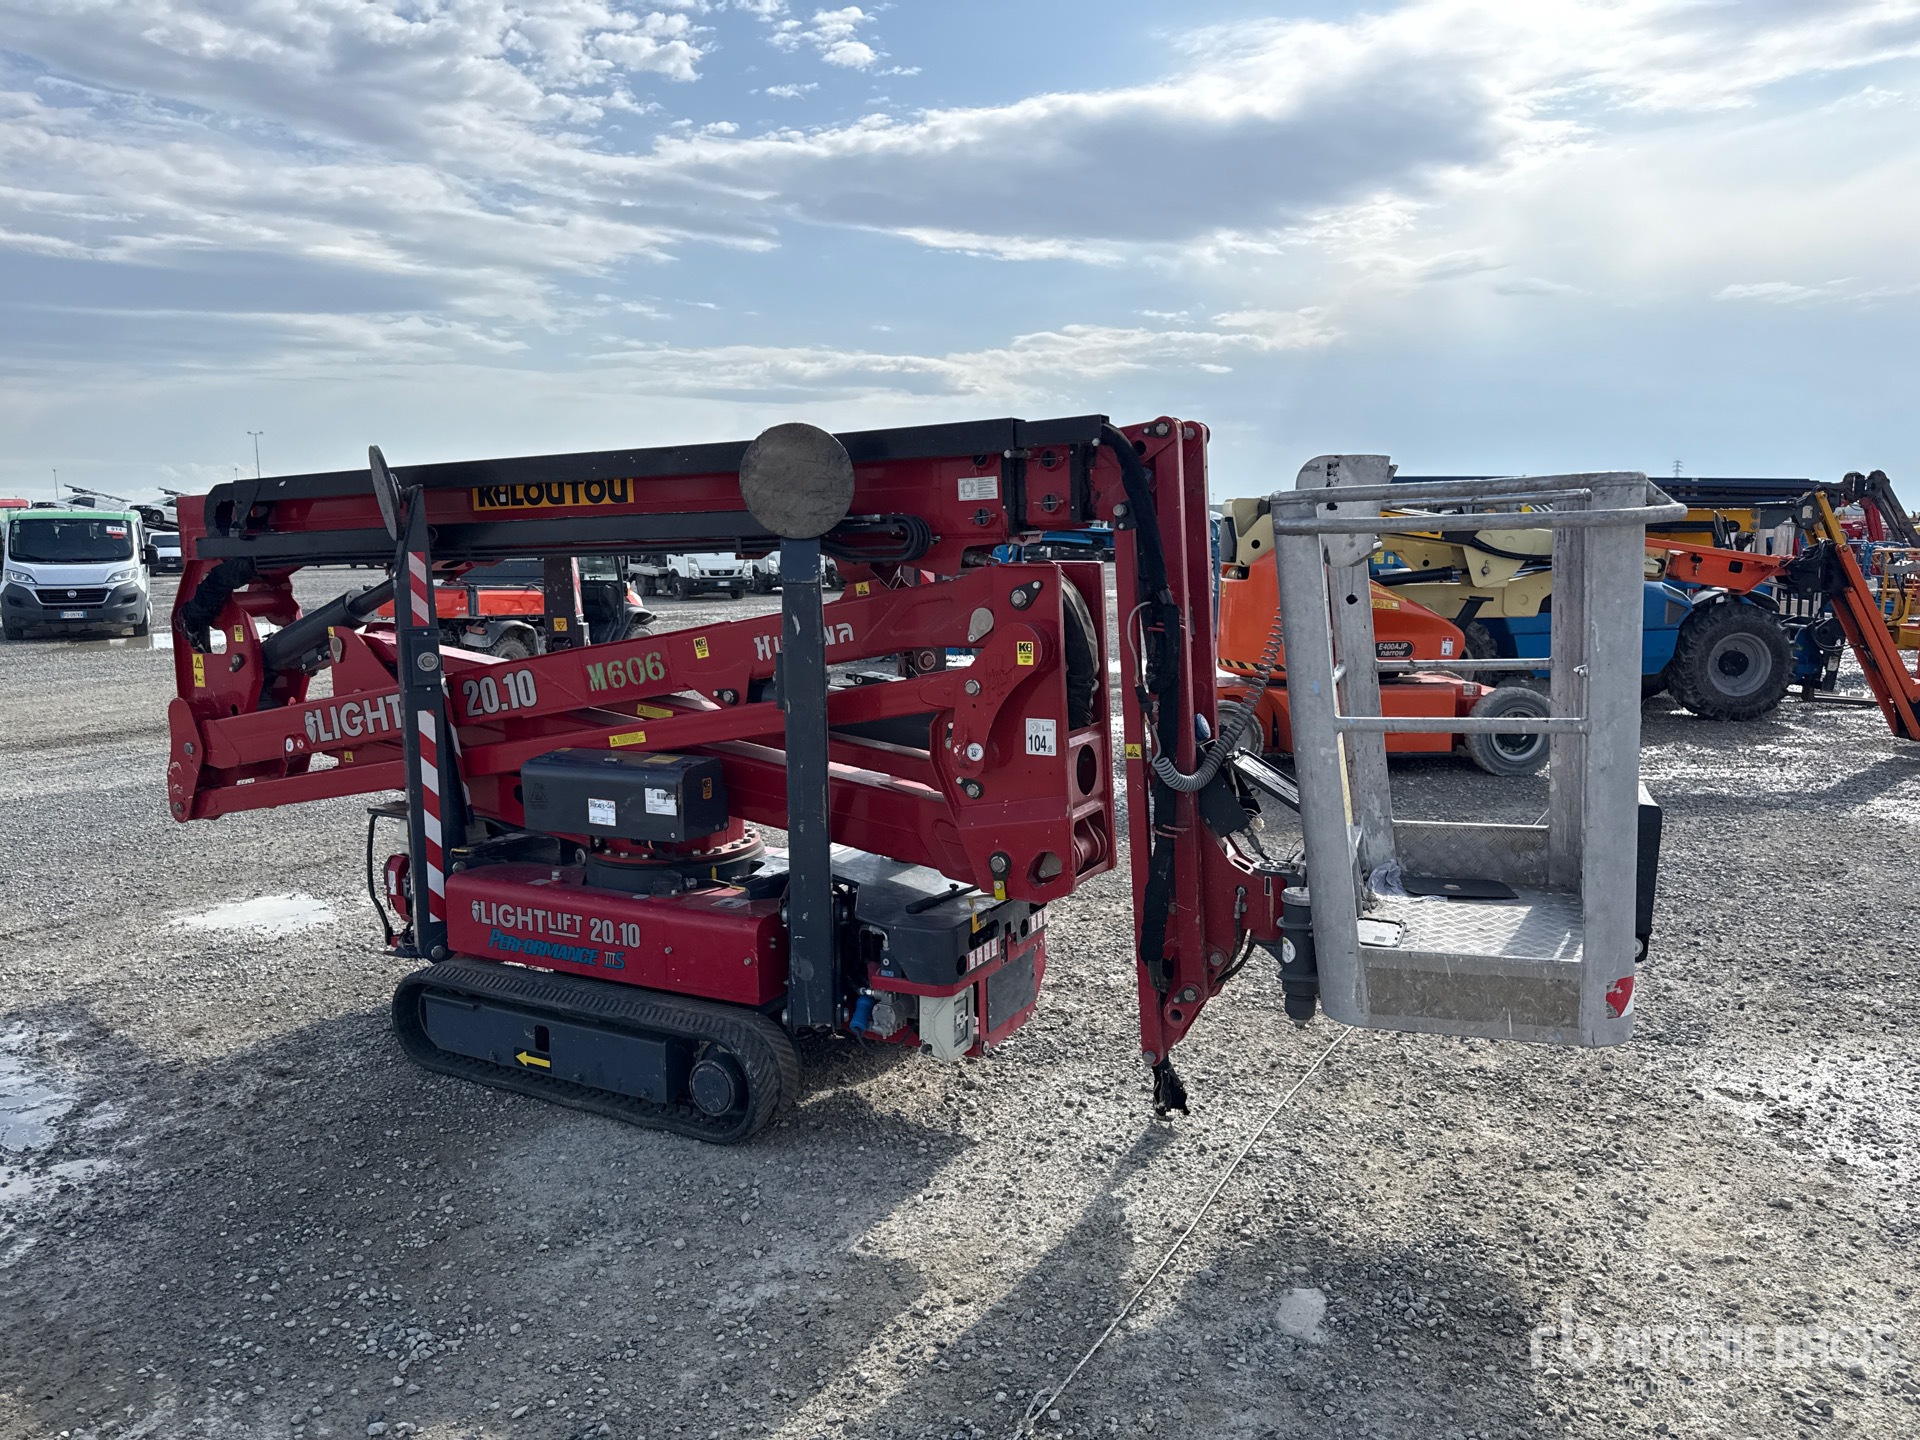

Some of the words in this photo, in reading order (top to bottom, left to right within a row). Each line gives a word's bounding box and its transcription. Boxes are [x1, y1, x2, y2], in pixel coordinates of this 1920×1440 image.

[1379, 643, 1408, 651] E400AJP
[586, 651, 665, 692] M606
[462, 669, 538, 718] 20.10
[1029, 734, 1046, 752] 104
[590, 917, 641, 948] 20.10
